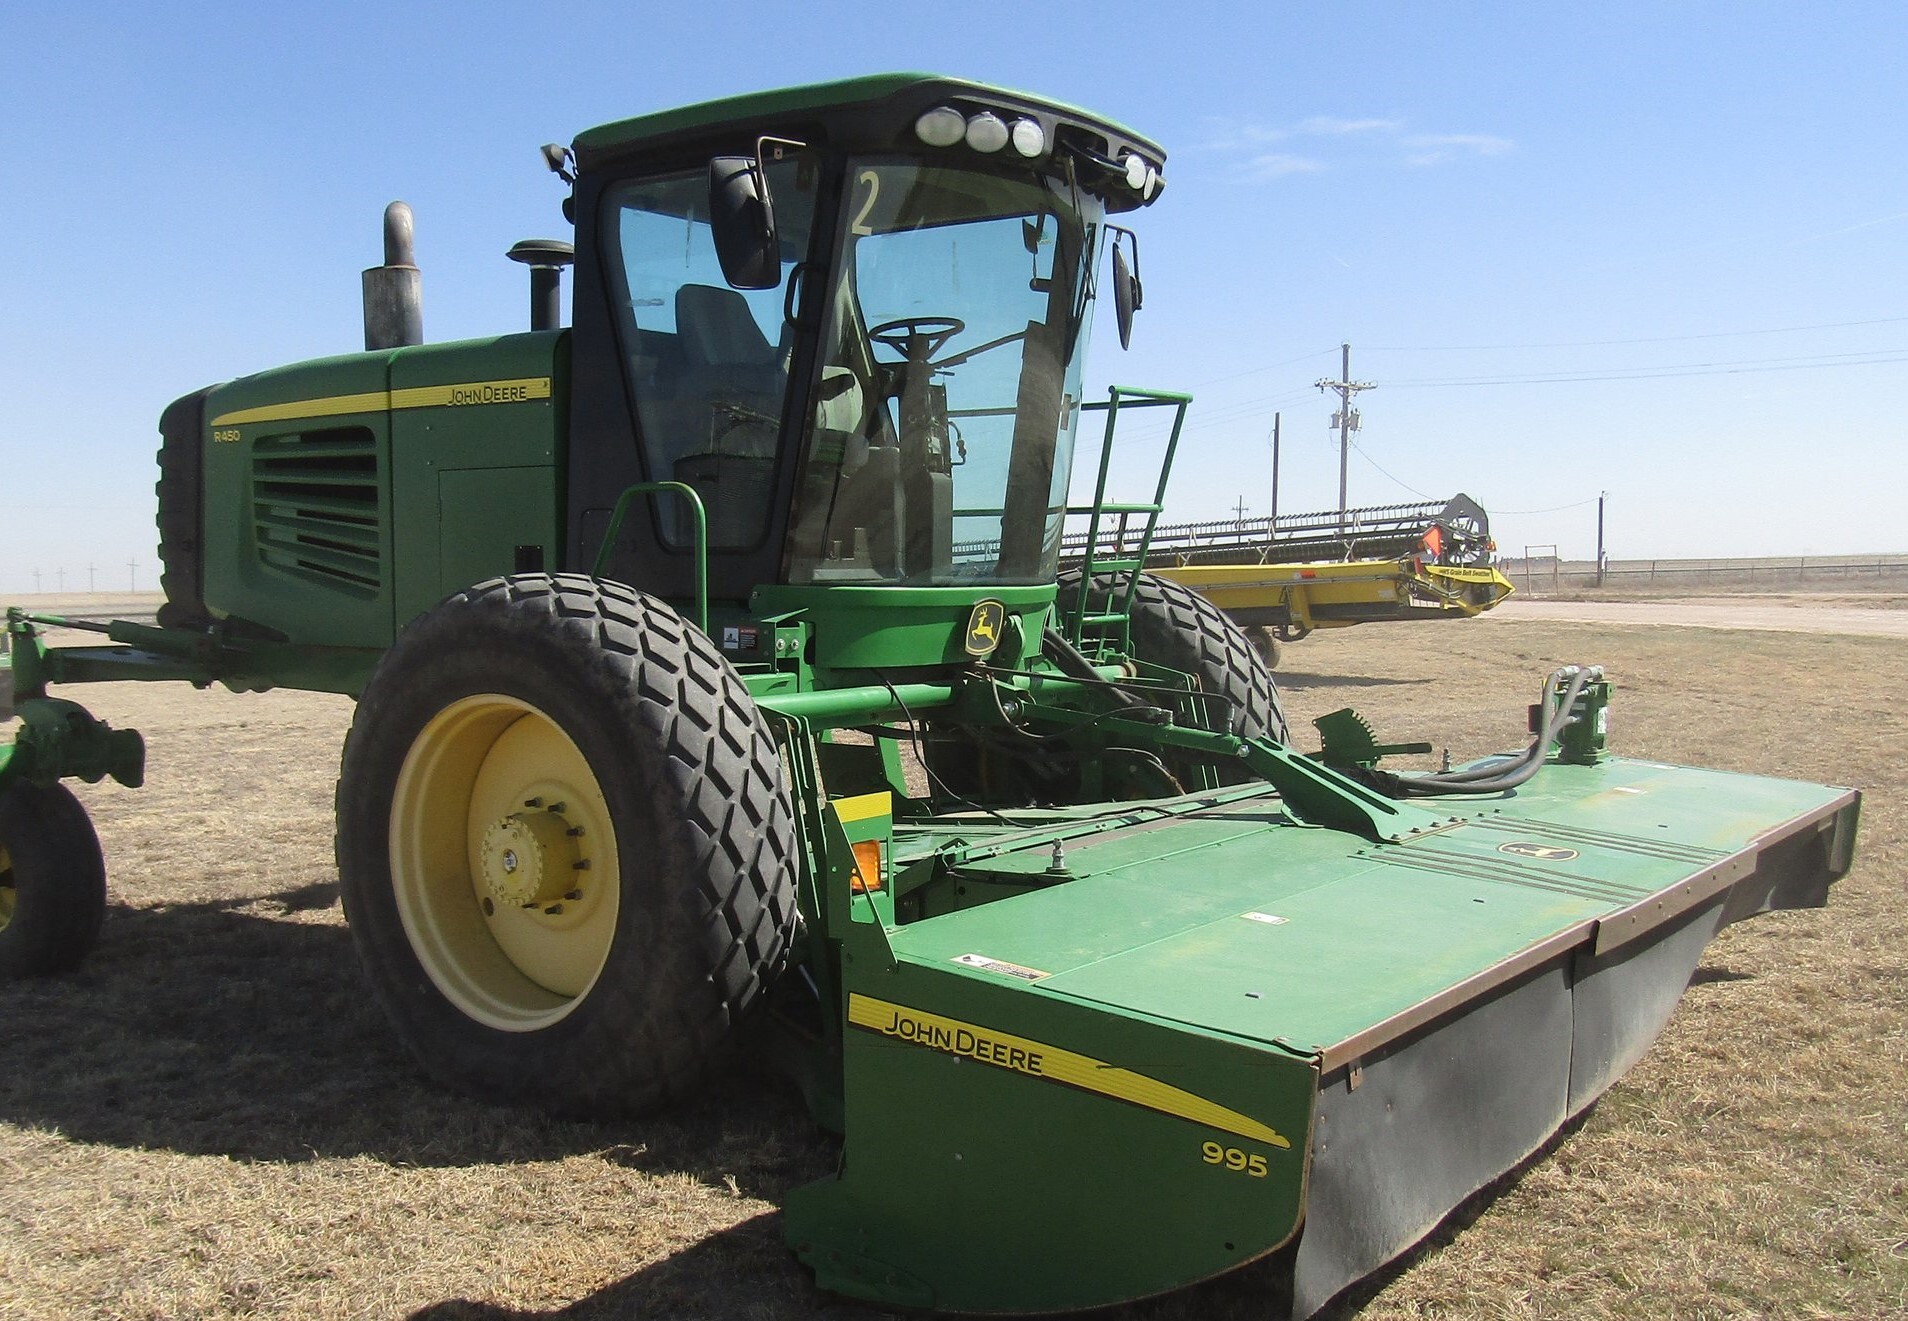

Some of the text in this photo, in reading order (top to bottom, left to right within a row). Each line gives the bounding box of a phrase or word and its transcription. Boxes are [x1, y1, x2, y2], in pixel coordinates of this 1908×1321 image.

[852, 170, 880, 236] 2
[448, 385, 528, 405] JOHN DEERE
[214, 430, 241, 443] R450
[884, 1011, 1044, 1074] JOHN DEERE
[1202, 1140, 1268, 1178] 995
